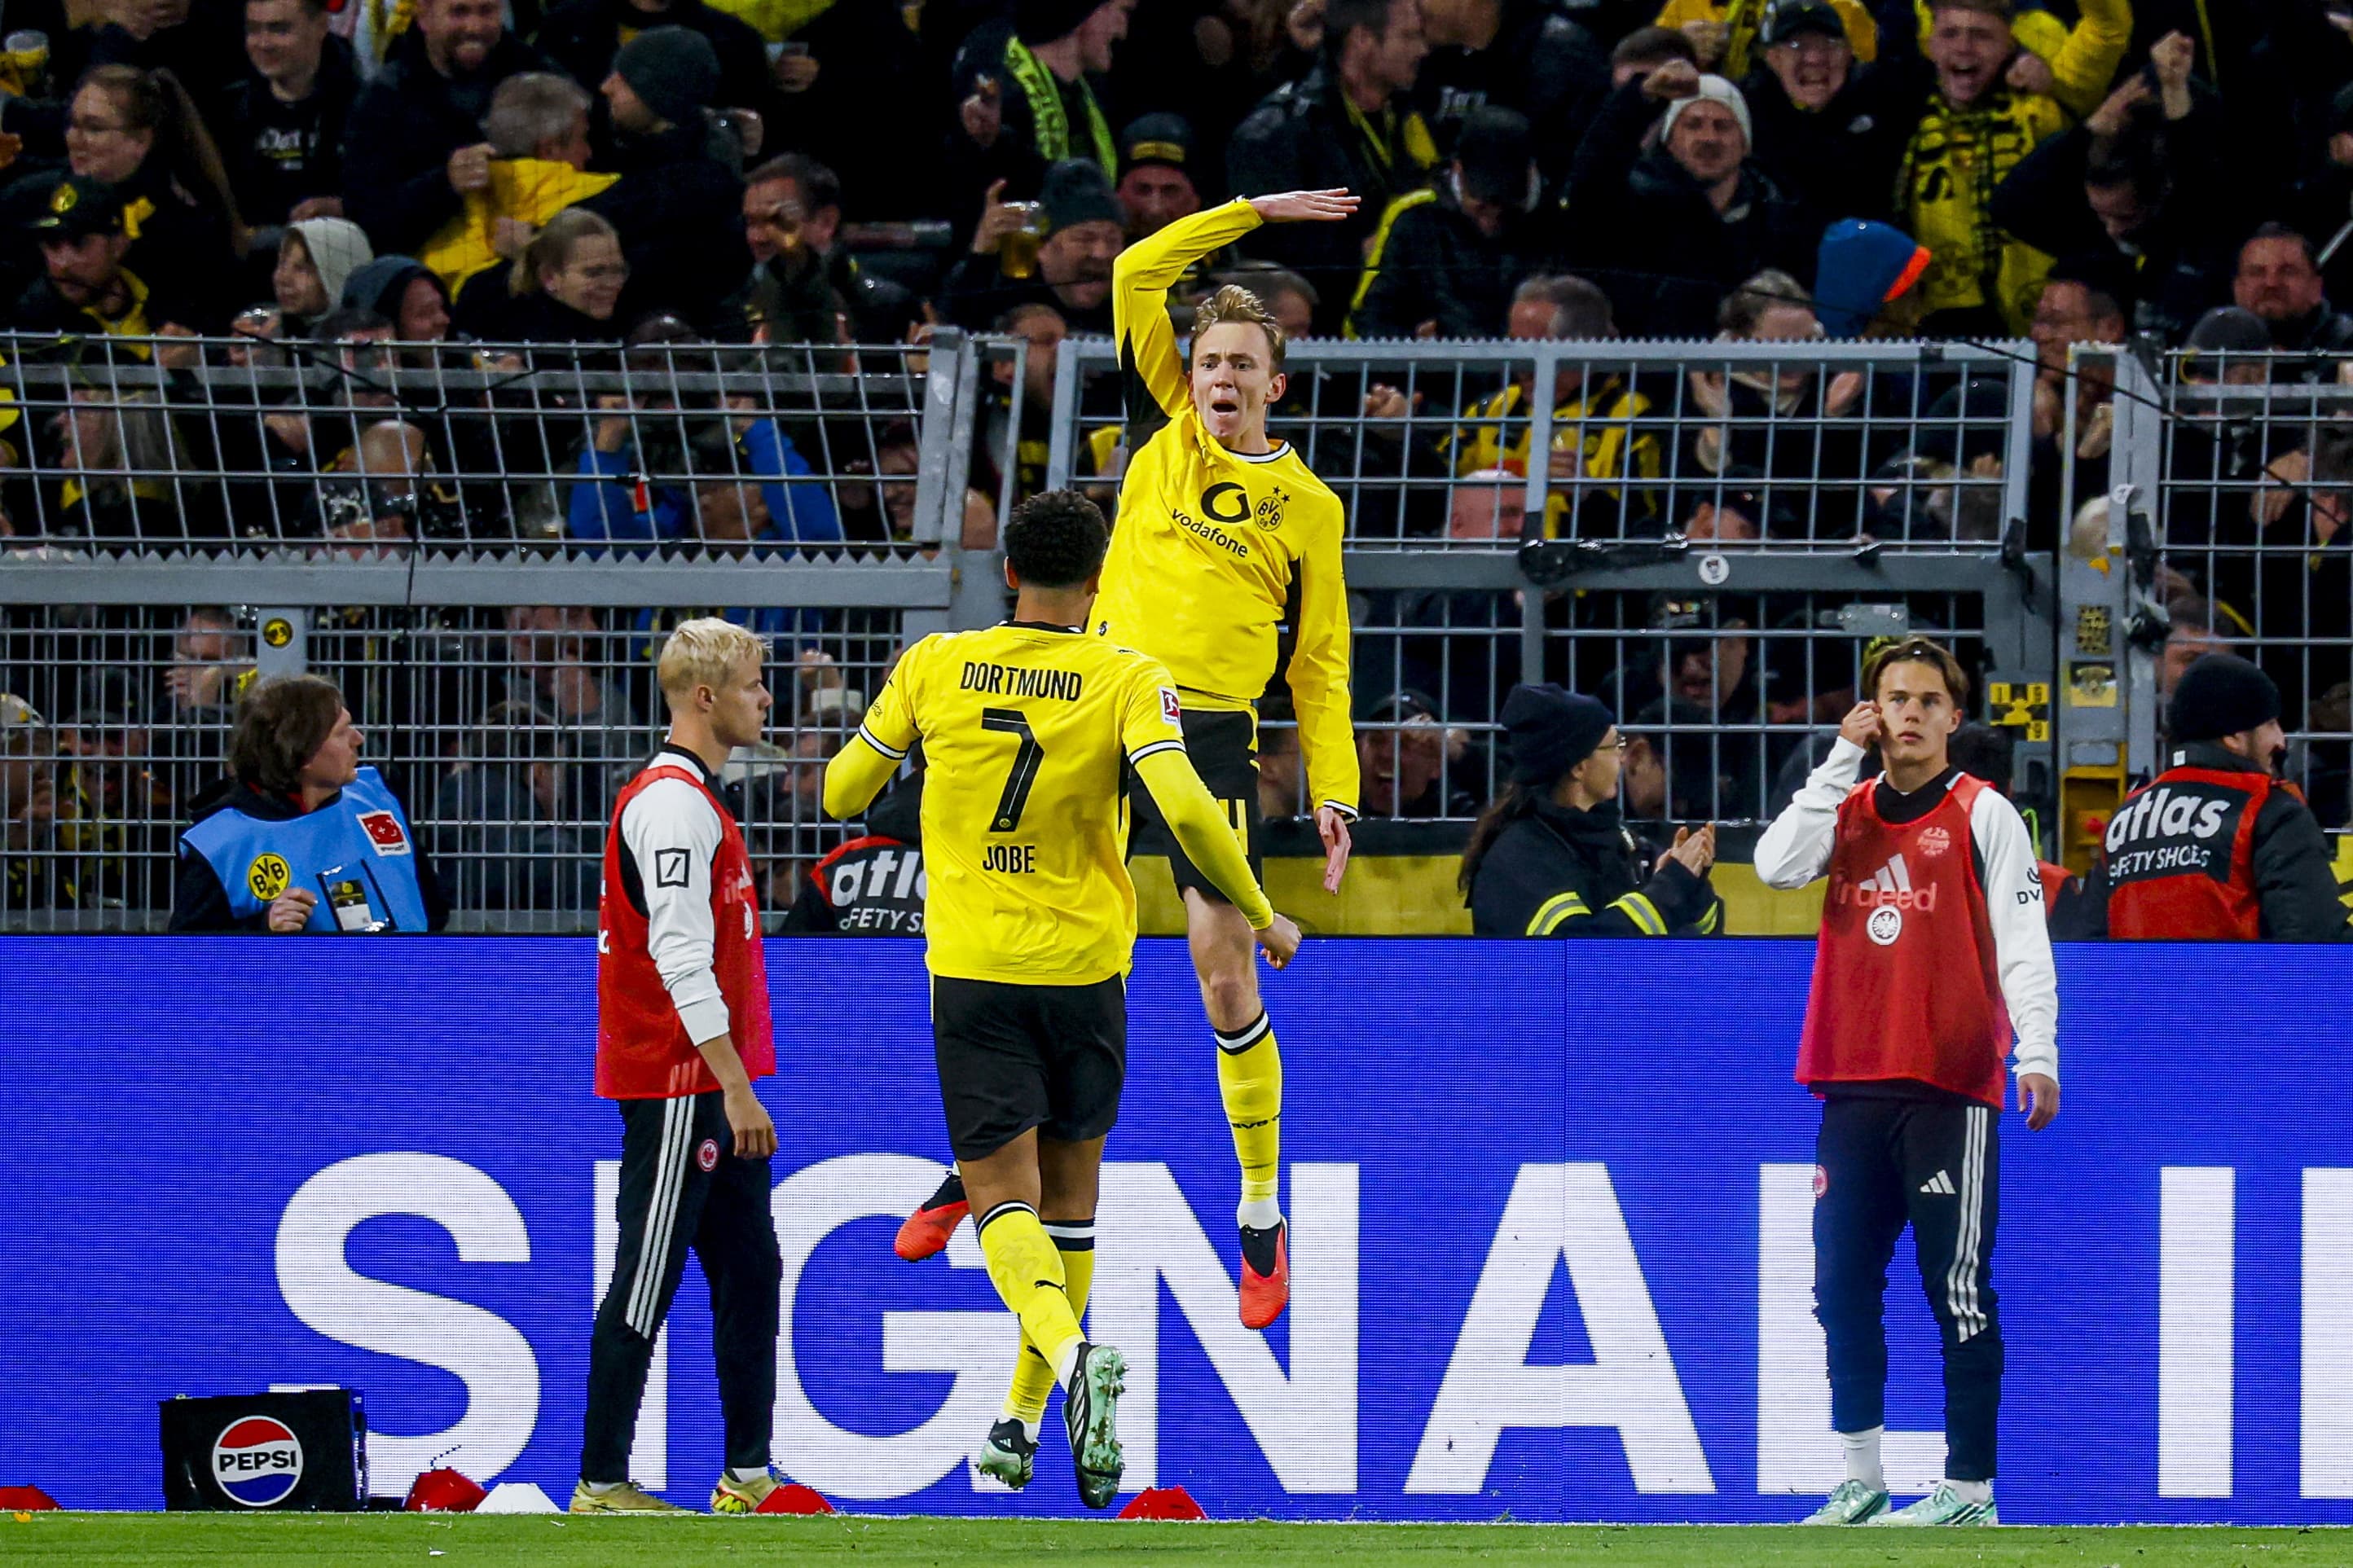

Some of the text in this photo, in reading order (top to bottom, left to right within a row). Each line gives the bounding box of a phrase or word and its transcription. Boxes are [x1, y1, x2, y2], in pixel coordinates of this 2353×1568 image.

[1258, 499, 1281, 526] BVB
[1171, 507, 1249, 559] vodafone
[960, 661, 1083, 702] DORTMUND
[981, 707, 1046, 832] 7
[2105, 788, 2232, 854] atlas
[253, 857, 285, 894] BVB
[982, 844, 1036, 874] JOBE
[906, 911, 926, 934] S
[2157, 1166, 2353, 1500] I
[218, 1450, 297, 1473] PEPSI
